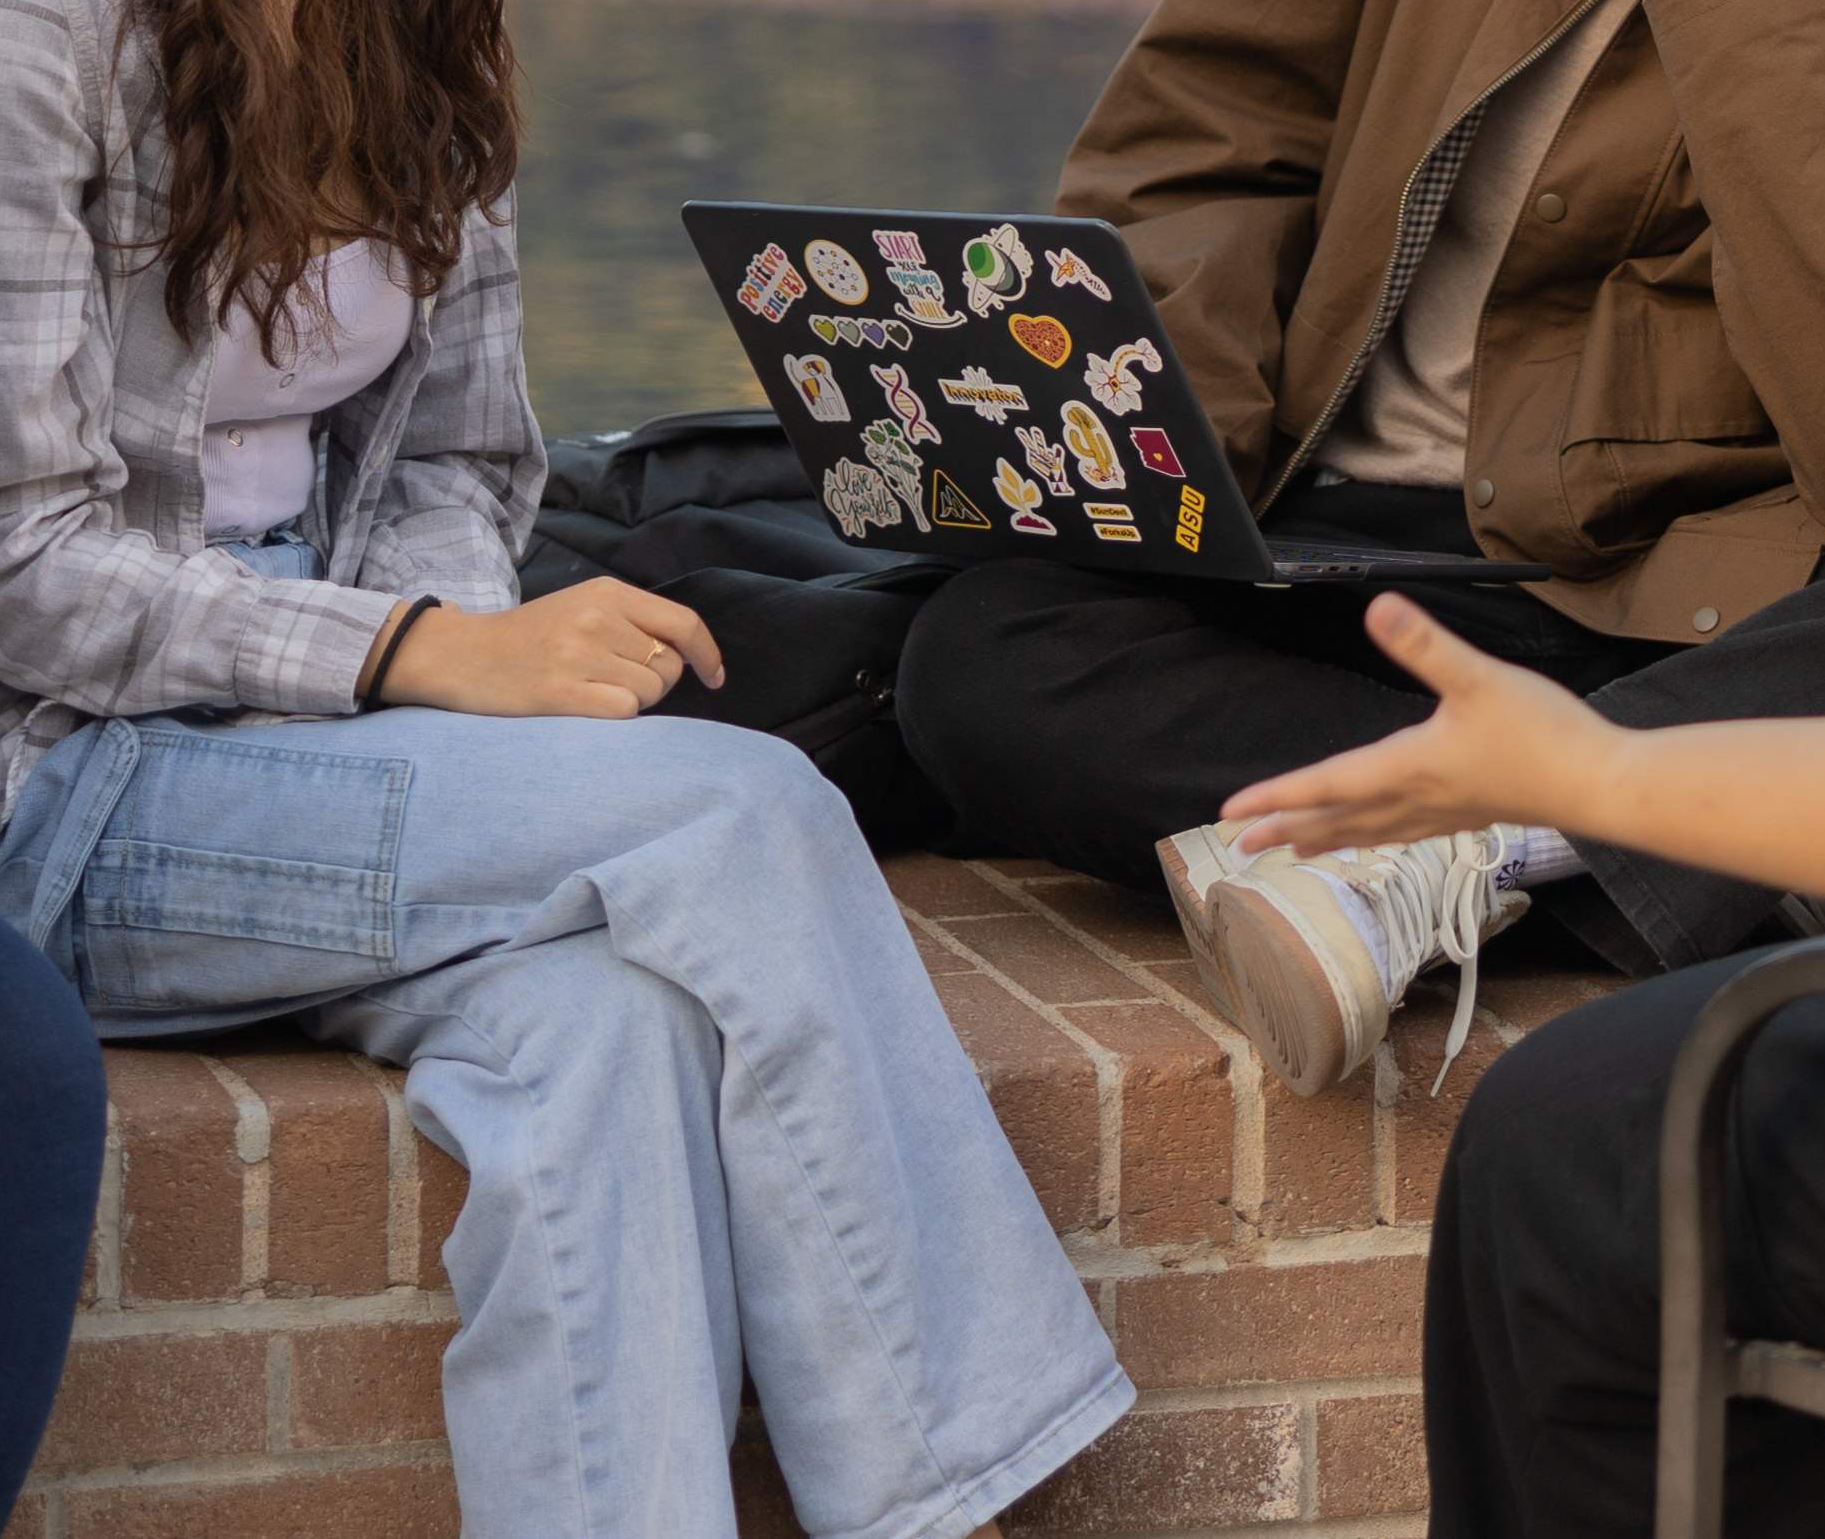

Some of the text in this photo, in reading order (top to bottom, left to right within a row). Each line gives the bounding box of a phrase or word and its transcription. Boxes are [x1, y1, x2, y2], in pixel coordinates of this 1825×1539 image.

[876, 235, 924, 262] START
[740, 246, 784, 311] positive
[763, 267, 804, 319] energy
[941, 382, 1026, 405] Innovator
[1180, 490, 1201, 548] ASU
